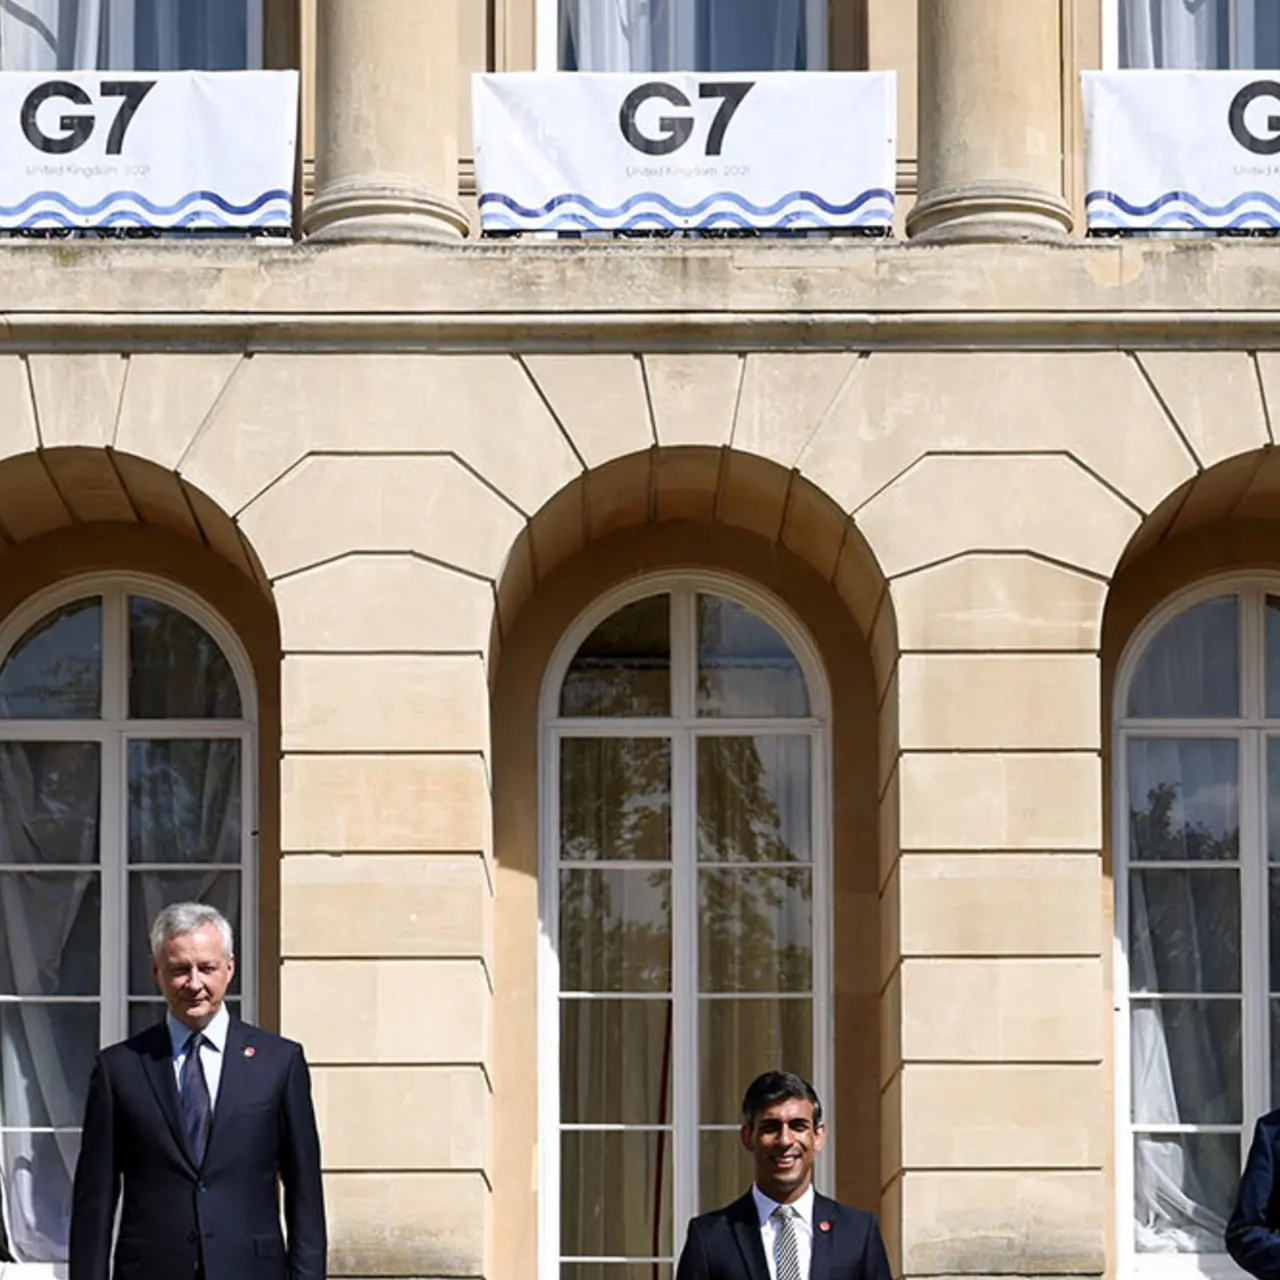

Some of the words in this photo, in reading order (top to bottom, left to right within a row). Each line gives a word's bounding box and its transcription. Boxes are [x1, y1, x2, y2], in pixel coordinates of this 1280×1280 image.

[20, 80, 156, 155] G7
[619, 81, 756, 155] G7
[66, 165, 118, 178] Kingdom
[625, 166, 663, 177] United
[666, 166, 718, 179] Kingdom
[723, 165, 751, 177] 2021
